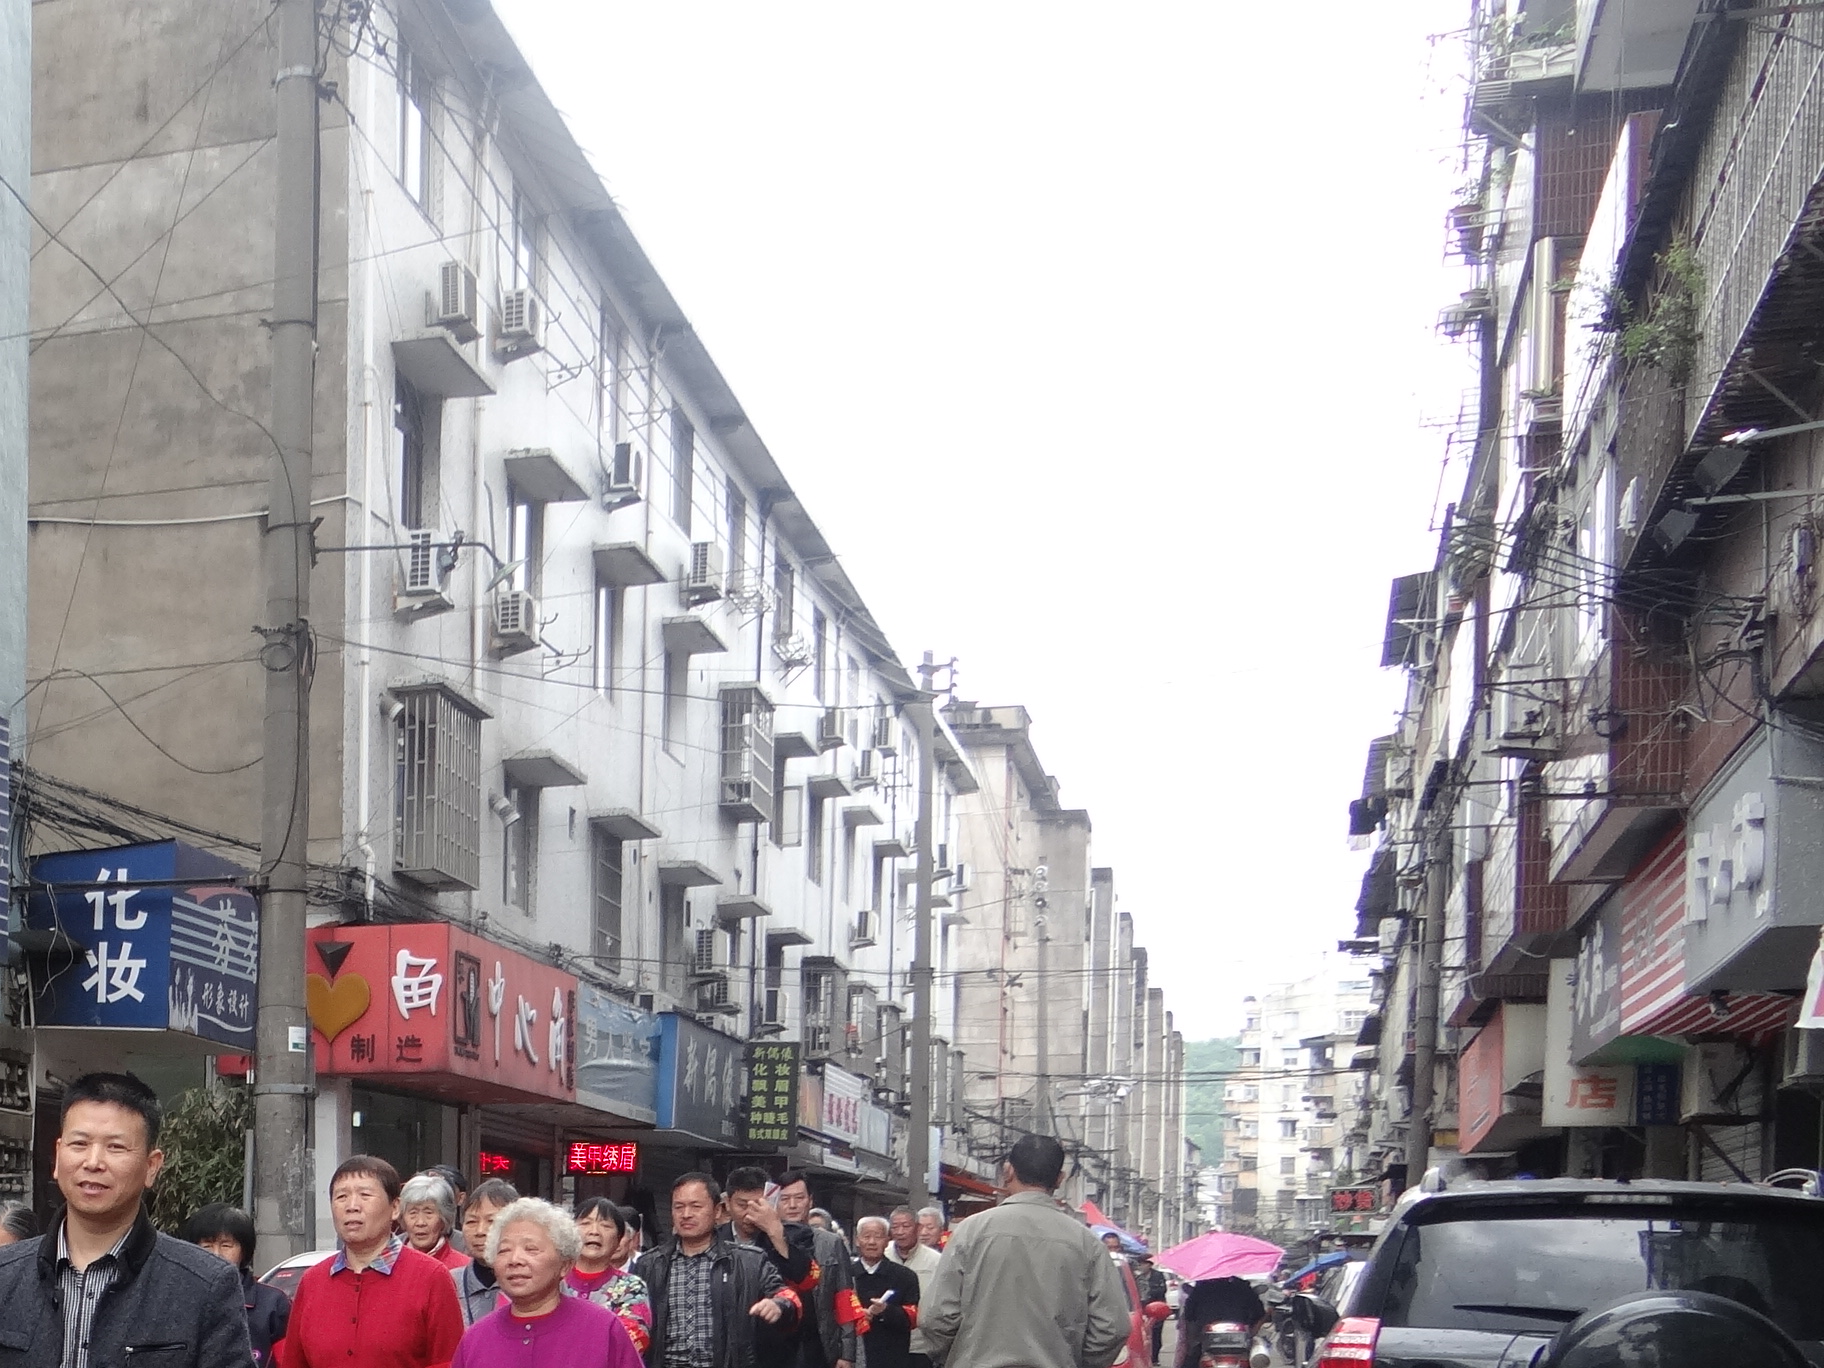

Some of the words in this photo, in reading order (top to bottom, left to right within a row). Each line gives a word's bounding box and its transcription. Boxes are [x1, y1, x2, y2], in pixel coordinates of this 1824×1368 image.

[82, 868, 147, 1006] 化妆
[351, 1034, 423, 1063] 制造
[752, 1063, 790, 1076] 化妆
[751, 1096, 789, 1108] 美甲
[1565, 1075, 1617, 1109] 店
[570, 1144, 636, 1171] 美甲绣眉
